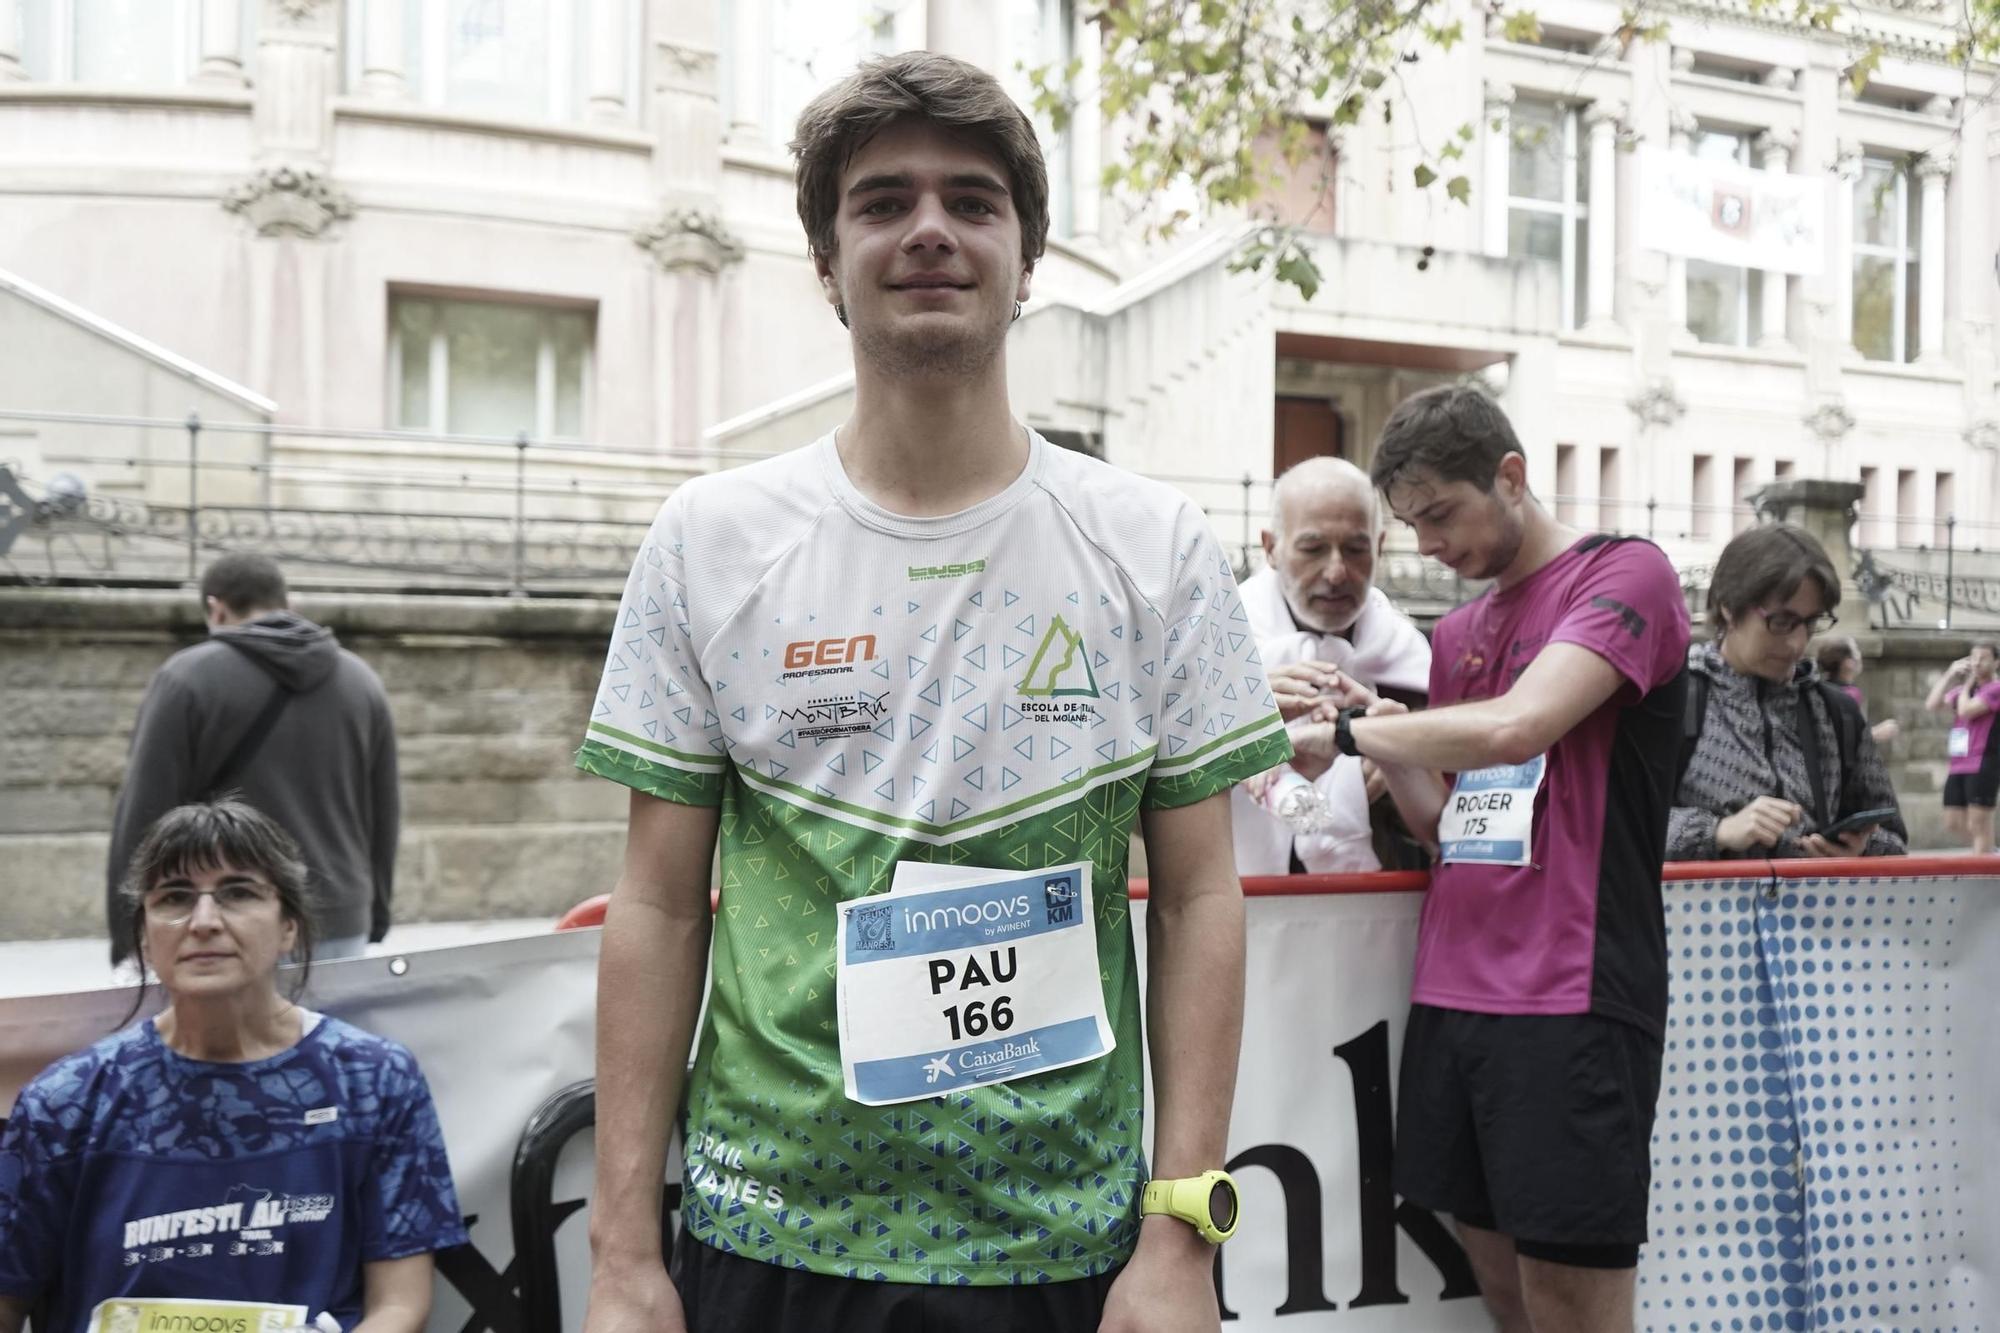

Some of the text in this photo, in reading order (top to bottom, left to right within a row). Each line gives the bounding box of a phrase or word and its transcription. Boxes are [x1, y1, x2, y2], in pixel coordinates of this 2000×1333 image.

[784, 634, 876, 670] GEN
[782, 666, 854, 680] PROFESSIONAL
[1021, 702, 1059, 712] ESCOLA
[1063, 702, 1077, 712] DE
[1034, 713, 1050, 723] DEL
[1456, 793, 1513, 814] ROGER
[1463, 817, 1488, 836] 175
[904, 895, 1030, 934] inmoovs
[1047, 905, 1073, 925] KM
[984, 919, 1031, 937] by AVINENT
[928, 947, 1017, 995] PAU
[942, 996, 1014, 1041] 166
[958, 1036, 1041, 1070] CaixaBank
[150, 1311, 247, 1333] inmoovs
